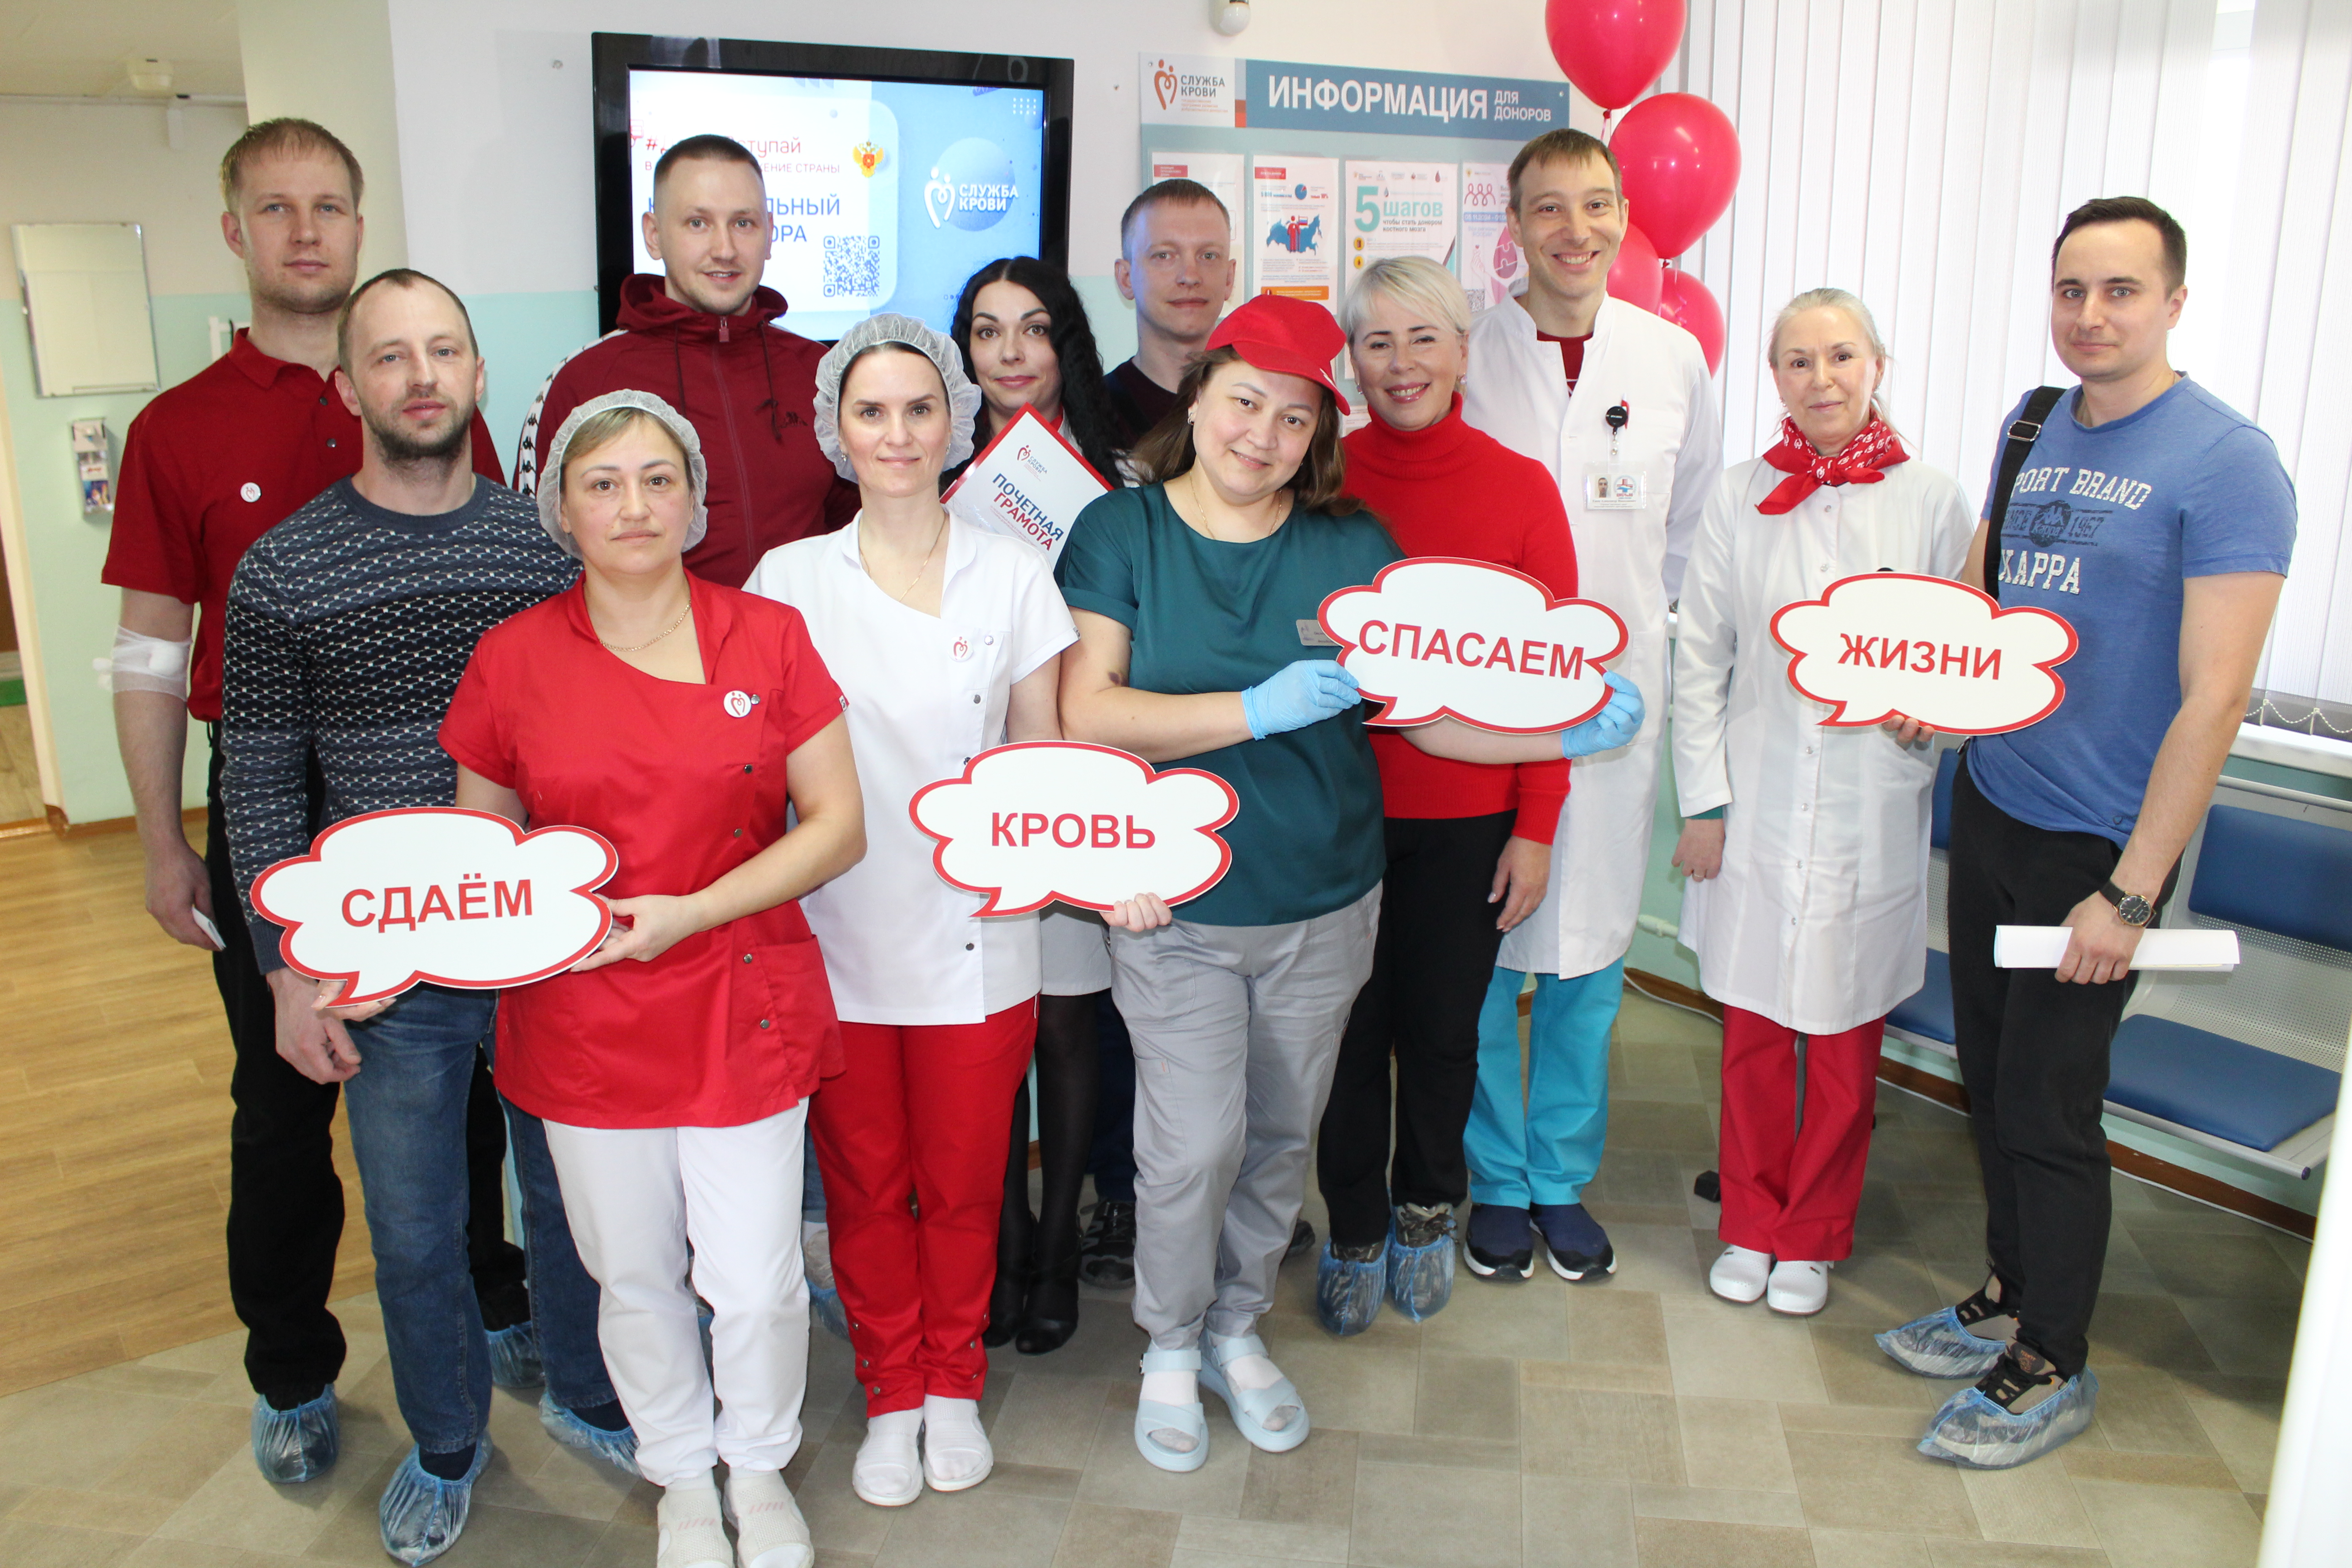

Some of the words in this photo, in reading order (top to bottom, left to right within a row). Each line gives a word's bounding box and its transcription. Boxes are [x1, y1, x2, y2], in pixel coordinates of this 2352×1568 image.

[1181, 75, 1225, 87] СЛУЖБА
[1181, 86, 1216, 97] КРОВИ
[1269, 75, 1488, 122] ИНФОРМАЦИЯ
[1494, 90, 1519, 104] ДЛЯ
[1494, 106, 1551, 122] ДОНОРОВ
[796, 163, 840, 173] СТРАНЫ
[959, 184, 1019, 198] СЛУЖБА
[959, 197, 1006, 211] КРОВИ
[1354, 186, 1381, 232] 5
[1383, 201, 1443, 216] шагов
[1027, 459, 1042, 473] КРОВИ
[1030, 456, 1048, 474] СЛУЖБА
[2010, 466, 2070, 498] PORT
[2069, 468, 2153, 510] BRAND
[992, 473, 1064, 541] ПОЧЕТНАЯ
[994, 492, 1053, 551] ГРАМОТА
[1998, 549, 2081, 595] KAPPA
[1359, 620, 1584, 680] СПАСАЕМ
[1838, 633, 2002, 680] ЖИЗНИ
[992, 812, 1156, 849] КРОВЬ
[342, 873, 533, 933] СДАЁМ
